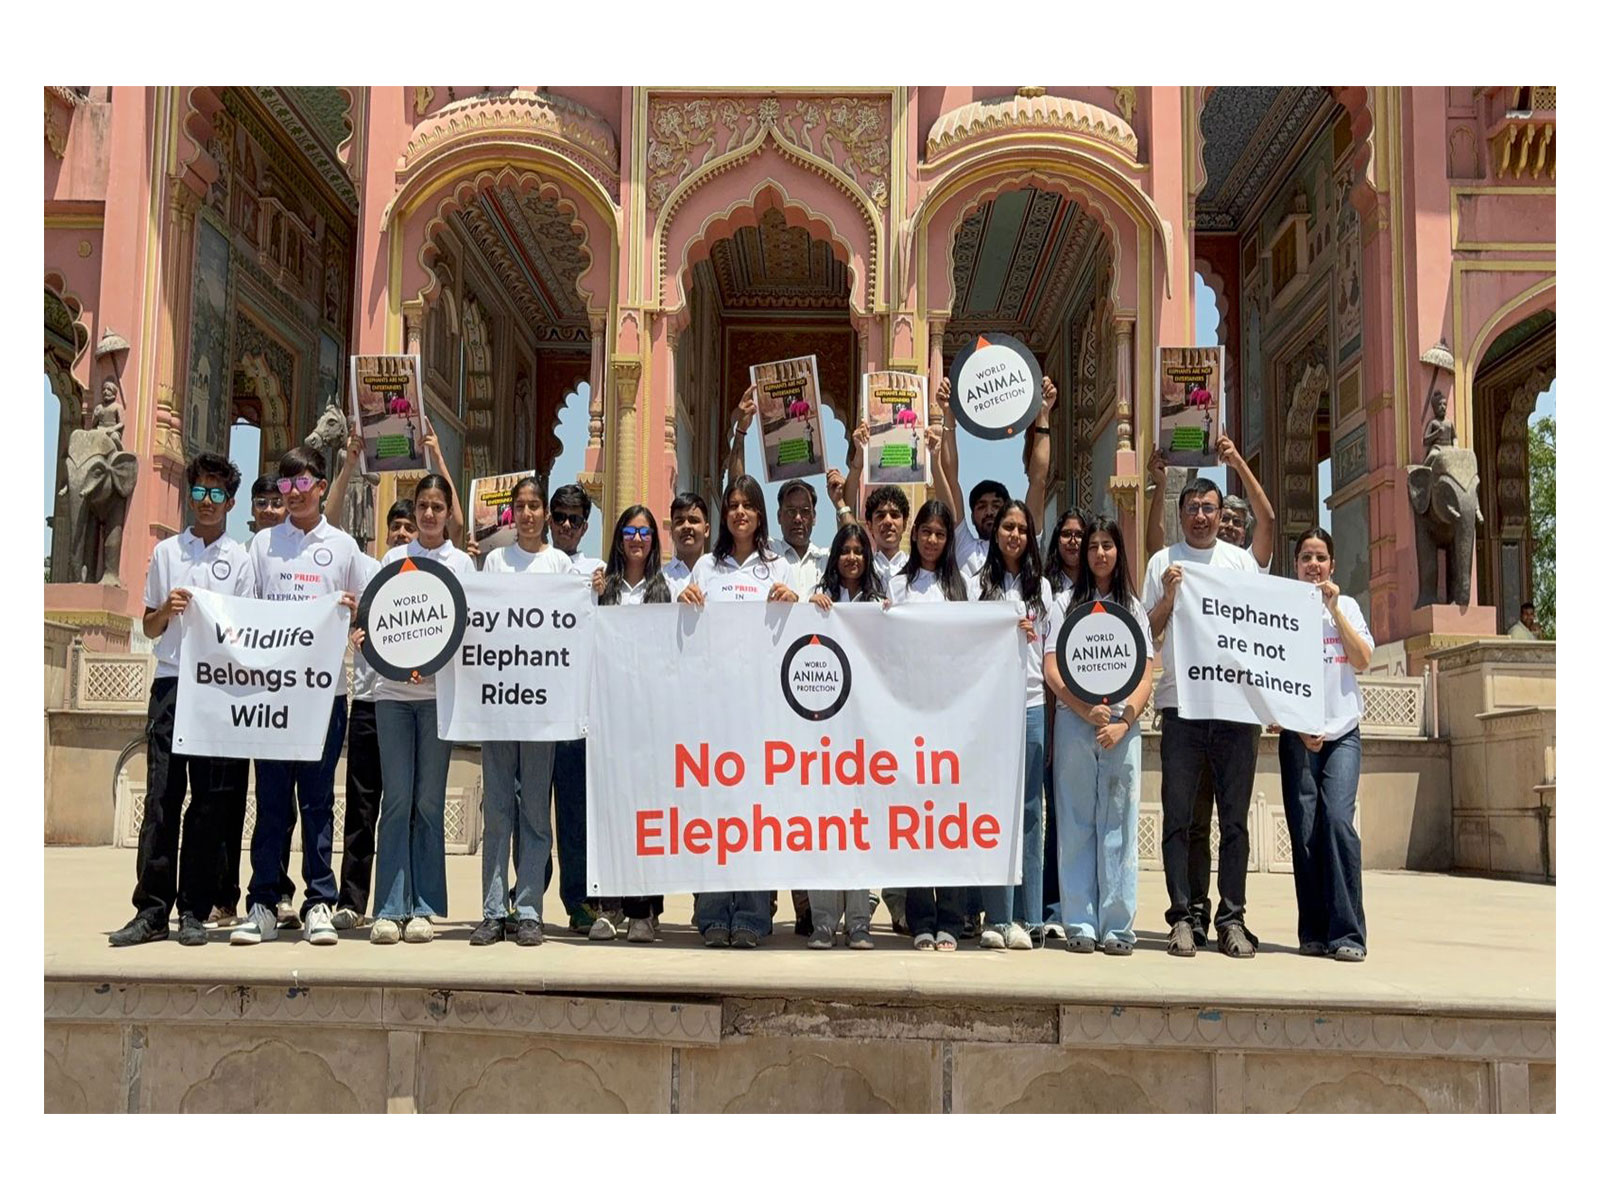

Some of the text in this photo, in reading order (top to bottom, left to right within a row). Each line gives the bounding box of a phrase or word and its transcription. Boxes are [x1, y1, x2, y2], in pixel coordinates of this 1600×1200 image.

[976, 363, 1006, 380] WORLD
[967, 369, 1026, 404] ANIMAL
[974, 387, 1026, 413] PROTECTION
[280, 573, 321, 583] NO PRIDE
[721, 584, 759, 593] NO PRIDE
[393, 593, 428, 607] WORLD
[376, 604, 448, 631] ANIMAL
[507, 607, 544, 628] NO
[551, 609, 577, 628] to
[1202, 597, 1299, 632] Elephants
[215, 622, 314, 649] Wildlife
[382, 624, 443, 645] PROTECTION
[1085, 633, 1115, 643] WORLD
[462, 644, 570, 671] Elephant
[1072, 643, 1131, 661] ANIMAL
[1217, 634, 1286, 661] are not
[196, 662, 332, 692] Belongs to
[793, 670, 839, 682] ANIMAL
[1077, 662, 1127, 672] PROTECTION
[481, 681, 548, 705] Rides
[796, 684, 836, 692] PROTECTION
[1188, 664, 1312, 698] entertainers
[231, 703, 289, 729] Wild
[675, 736, 960, 788] No Pride in
[636, 800, 1001, 865] Elephant Ride
